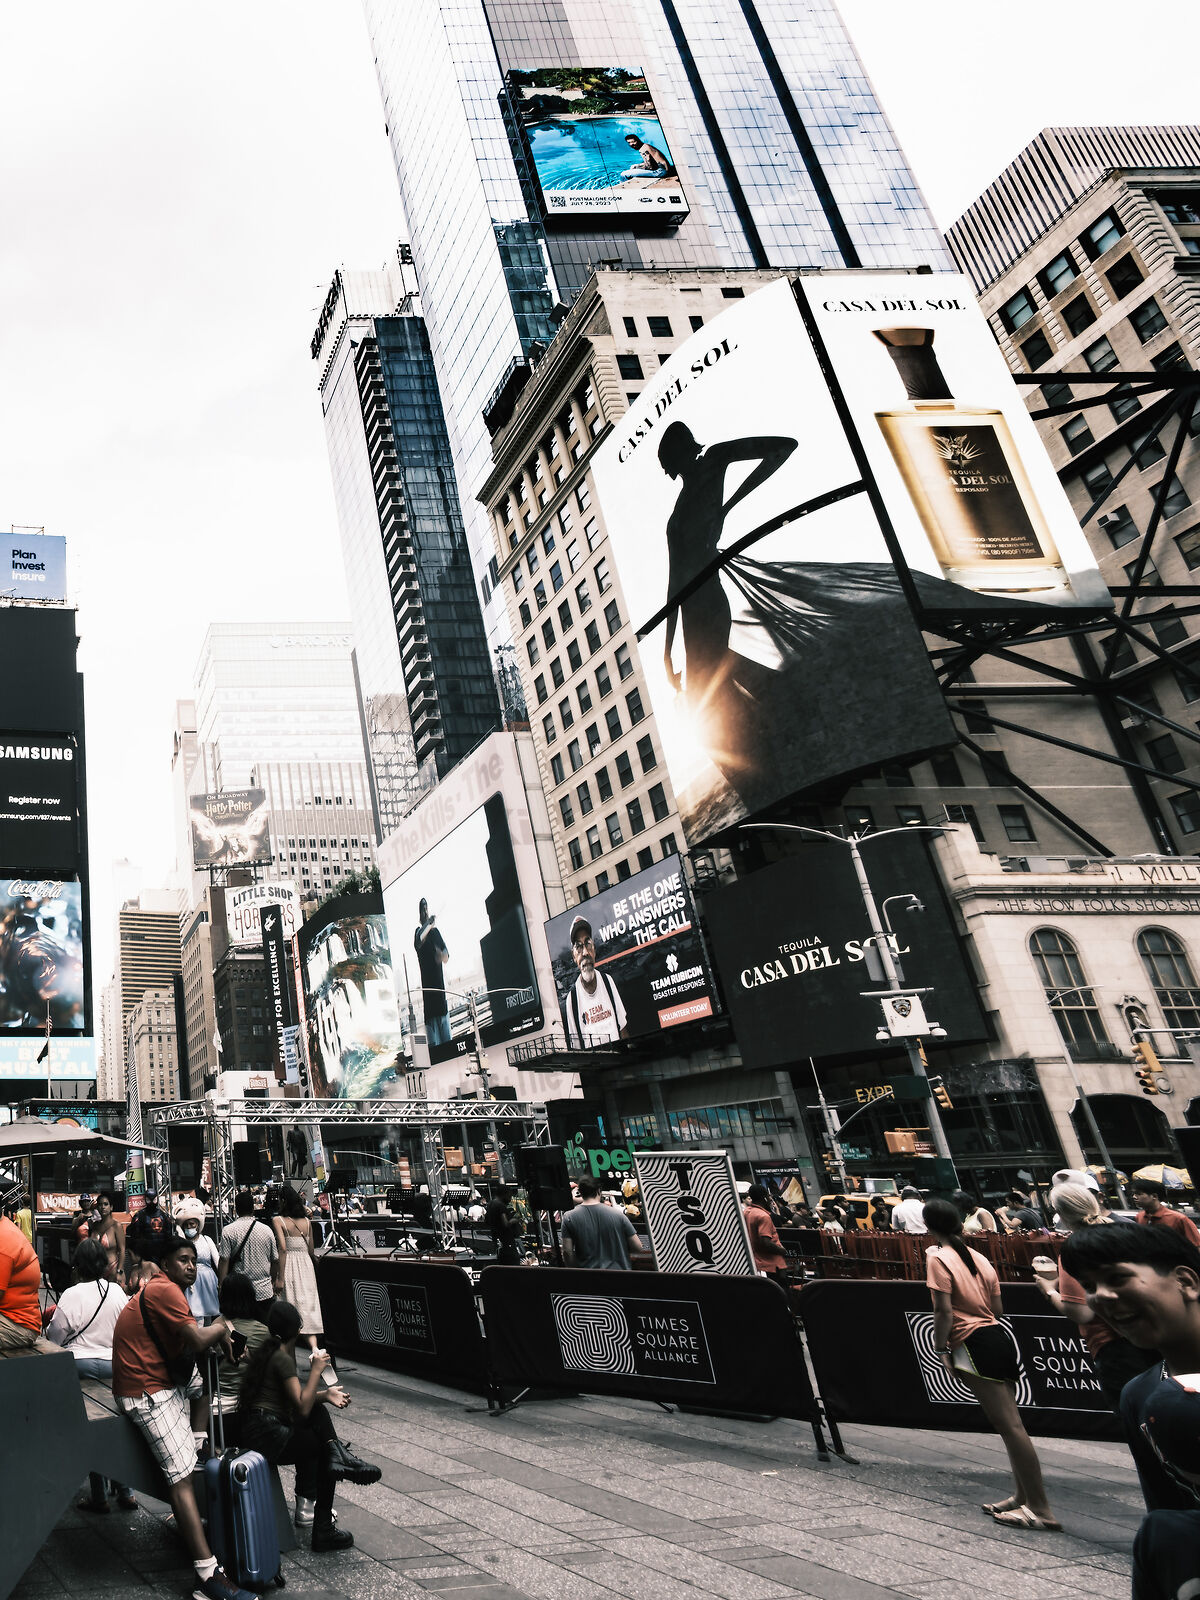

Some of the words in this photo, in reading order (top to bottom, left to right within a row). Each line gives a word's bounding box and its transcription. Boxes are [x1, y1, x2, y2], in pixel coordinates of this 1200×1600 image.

[823, 300, 877, 312] CASA
[882, 300, 923, 311] DEL
[926, 299, 966, 311] SOL
[618, 417, 654, 463] CASA
[655, 378, 688, 418] DEL
[691, 338, 738, 379] SOL
[960, 475, 988, 486] DEL
[989, 475, 1013, 484] SOL
[11, 549, 36, 559] Plan
[11, 560, 46, 571] Invest
[11, 570, 46, 581] Insure
[8, 796, 41, 806] Register
[205, 802, 228, 817] Harry
[227, 799, 253, 814] Potter
[233, 886, 266, 907] LITTLE
[268, 886, 294, 901] SHOP
[612, 899, 630, 918] BE
[629, 887, 653, 909] THE
[653, 872, 682, 897] ONE
[1001, 899, 1032, 911] THE
[1034, 899, 1075, 912] SHOW
[1084, 899, 1130, 912] FOLKS
[1136, 899, 1174, 911] SHOE
[599, 919, 627, 942] WHO
[628, 891, 686, 930] ANSWERS
[633, 923, 659, 946] THE
[658, 911, 691, 936] CALL
[778, 936, 822, 955] TEQUILA
[268, 940, 281, 996] EXCELLENCE
[740, 960, 789, 989] CASA
[789, 946, 841, 975] DEL
[844, 933, 910, 962] SL
[651, 975, 671, 991] TEAM
[670, 966, 704, 985] RUBICON
[653, 987, 678, 1001] DISASTER
[678, 978, 706, 992] RESPONSE
[275, 1000, 283, 1018] FOR
[589, 1004, 603, 1015] TEAM
[661, 1006, 690, 1022] VOLUNTEER
[690, 1002, 709, 1015] TODAY
[277, 1020, 285, 1033] UP
[279, 1033, 287, 1062] TEAM
[456, 1041, 467, 1051] TSX
[588, 1137, 655, 1178] pel
[40, 1194, 81, 1209] WONDE
[394, 1298, 422, 1312] TIMES
[394, 1311, 427, 1327] SQUARE
[637, 1315, 689, 1332] TIMES
[399, 1327, 428, 1339] ALLIANCE
[636, 1332, 700, 1350] SQUARE
[1033, 1336, 1091, 1354] TIME
[644, 1350, 700, 1365] ALLIANCE
[1032, 1356, 1097, 1375] SQUA
[1046, 1377, 1102, 1392] ALLIAN
